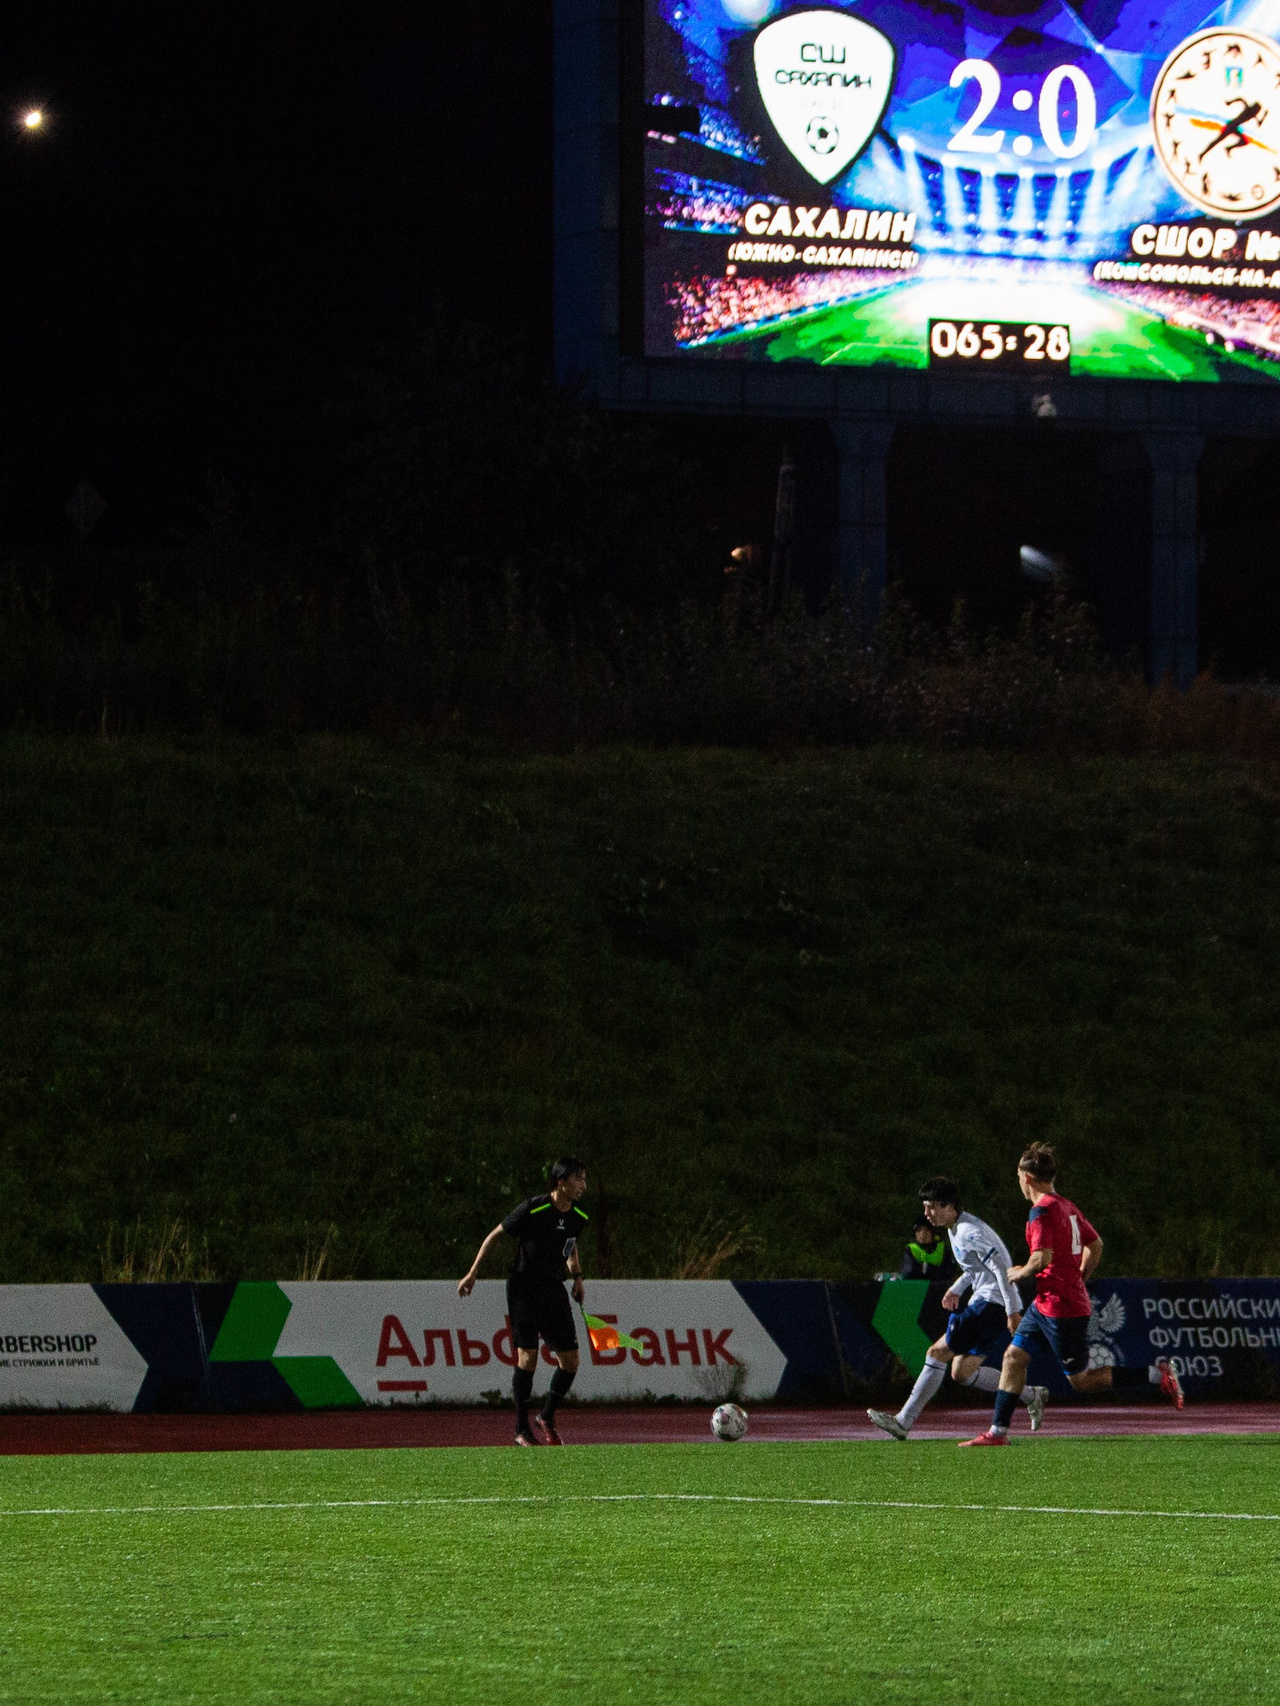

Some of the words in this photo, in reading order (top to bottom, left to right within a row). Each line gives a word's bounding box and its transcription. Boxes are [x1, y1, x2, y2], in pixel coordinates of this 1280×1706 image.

[801, 43, 846, 64] СШ
[947, 58, 1097, 159] 2:0
[744, 203, 917, 243] САХАЛИН
[1131, 223, 1238, 259] СШОР
